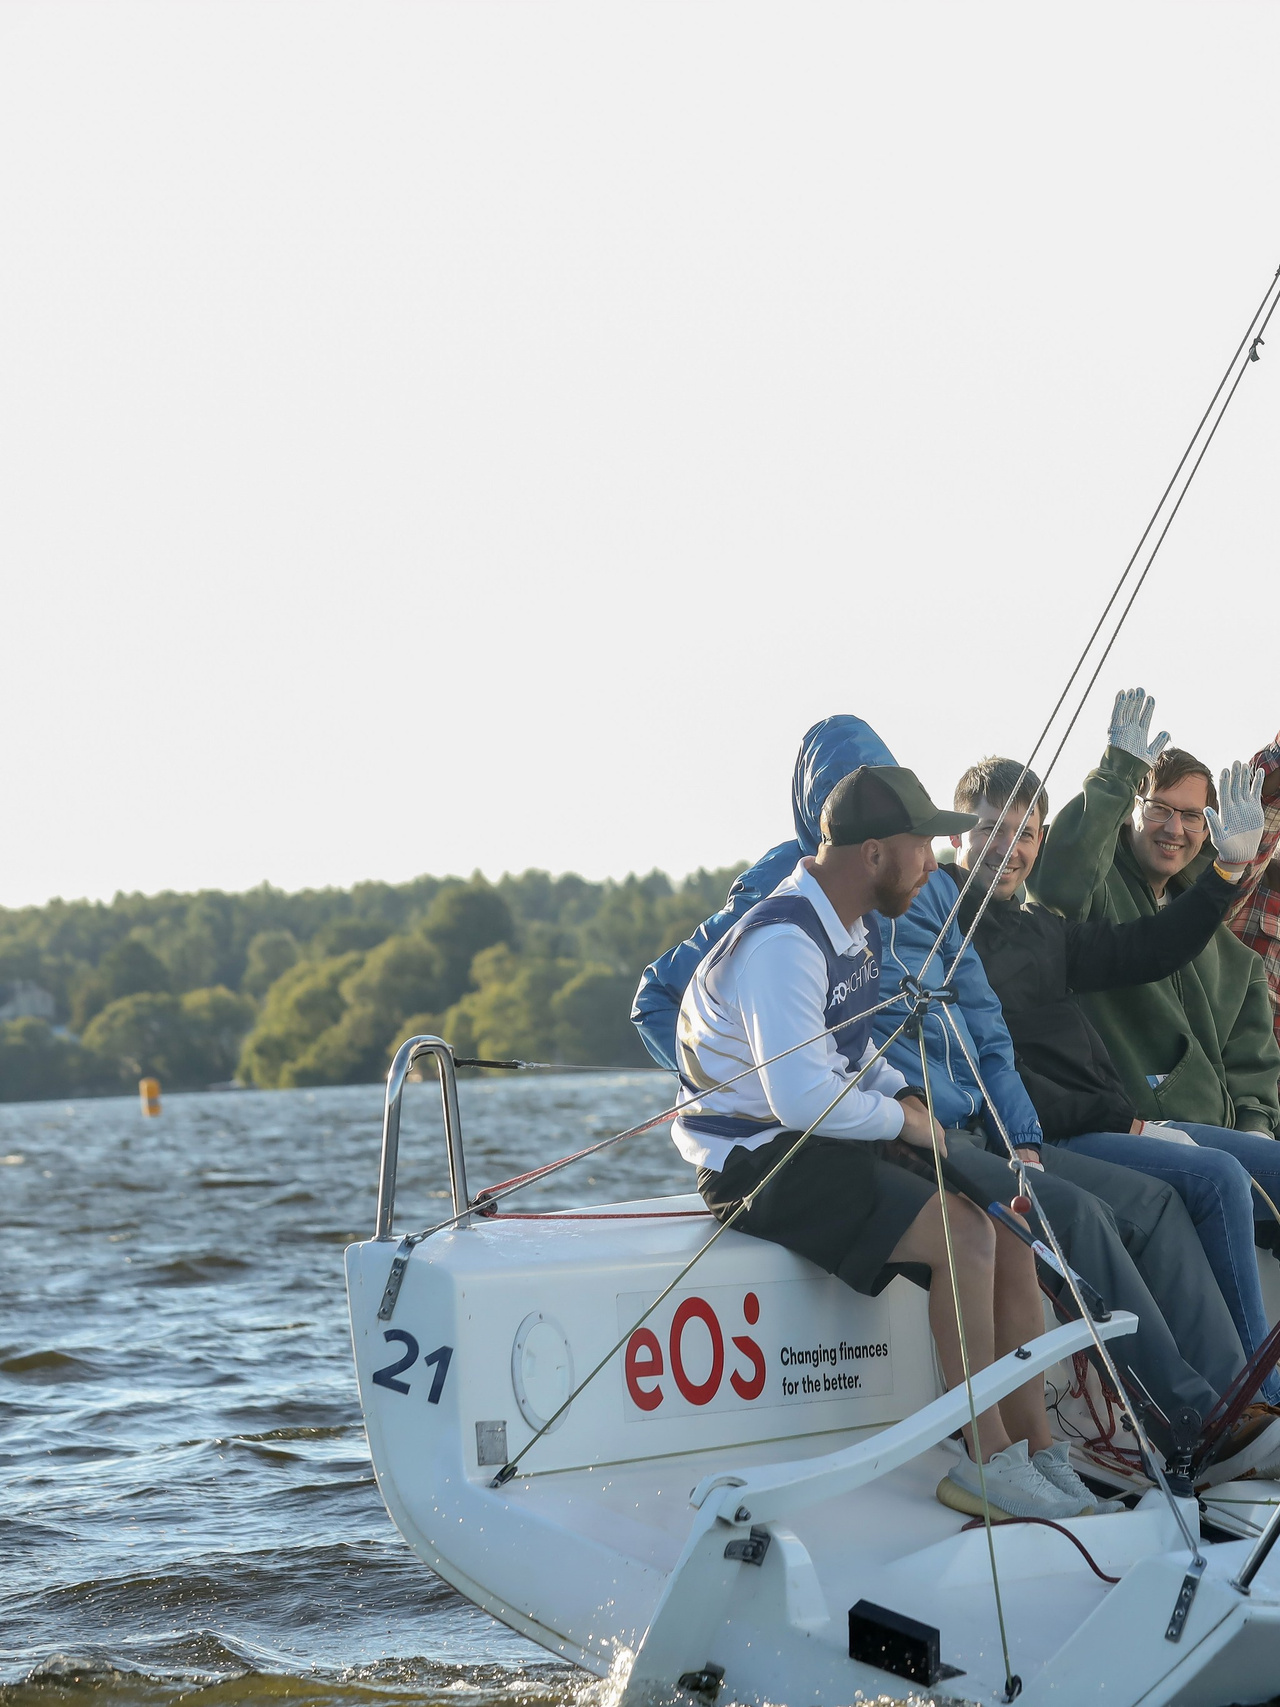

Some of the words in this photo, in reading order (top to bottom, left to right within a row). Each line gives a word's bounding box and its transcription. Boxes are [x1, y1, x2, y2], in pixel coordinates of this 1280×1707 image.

[372, 1328, 454, 1405] 21
[780, 1343, 838, 1368] Changing
[839, 1341, 888, 1361] finances
[782, 1376, 799, 1396] for
[802, 1374, 821, 1394] the
[823, 1372, 862, 1392] better.
